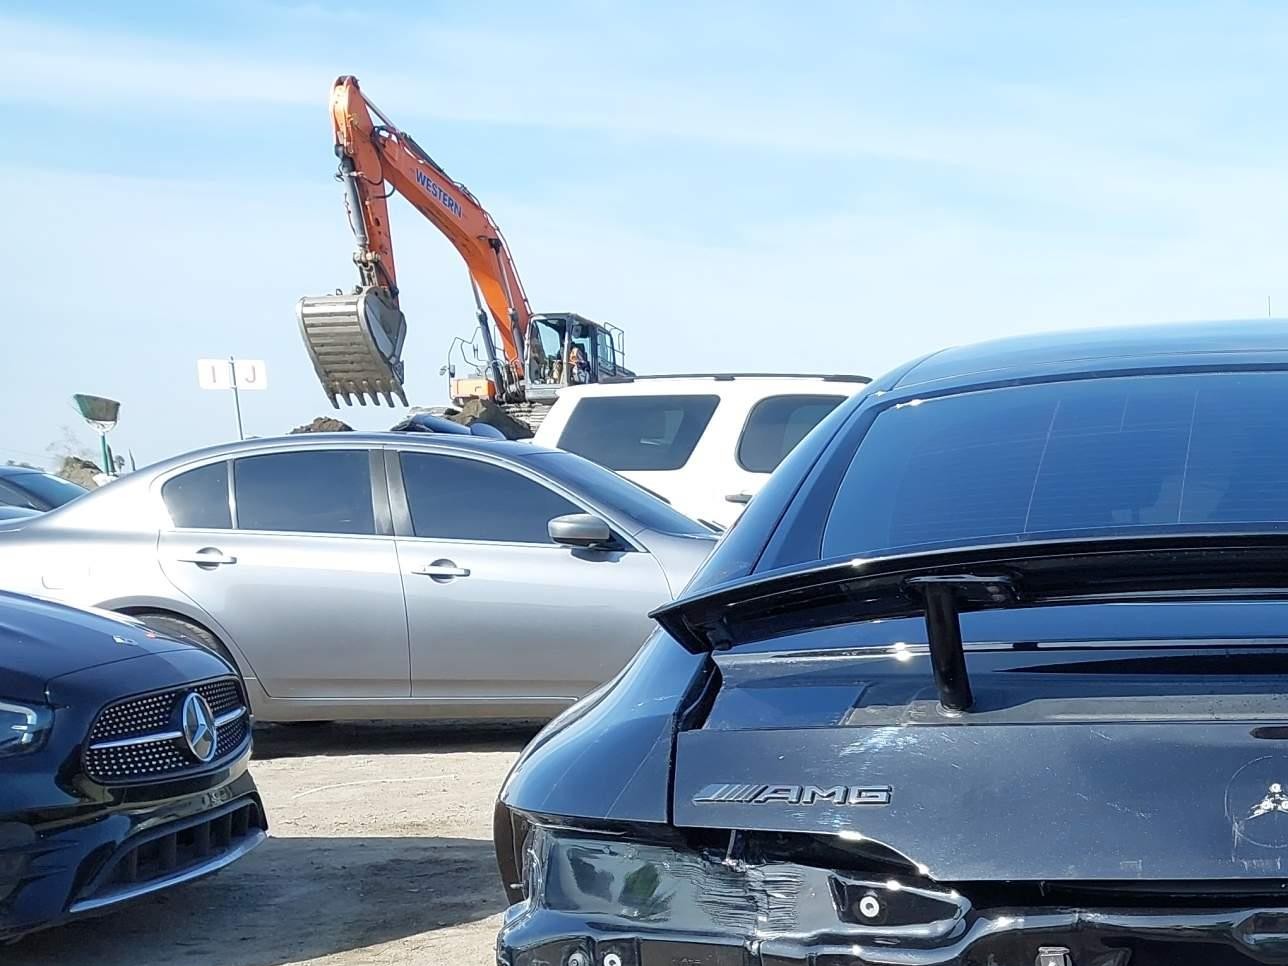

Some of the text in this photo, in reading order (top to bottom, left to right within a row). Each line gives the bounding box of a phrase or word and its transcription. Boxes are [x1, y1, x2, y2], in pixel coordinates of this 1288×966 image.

[415, 167, 463, 218] WESTERN
[245, 365, 256, 384] J
[753, 784, 893, 806] AMG
